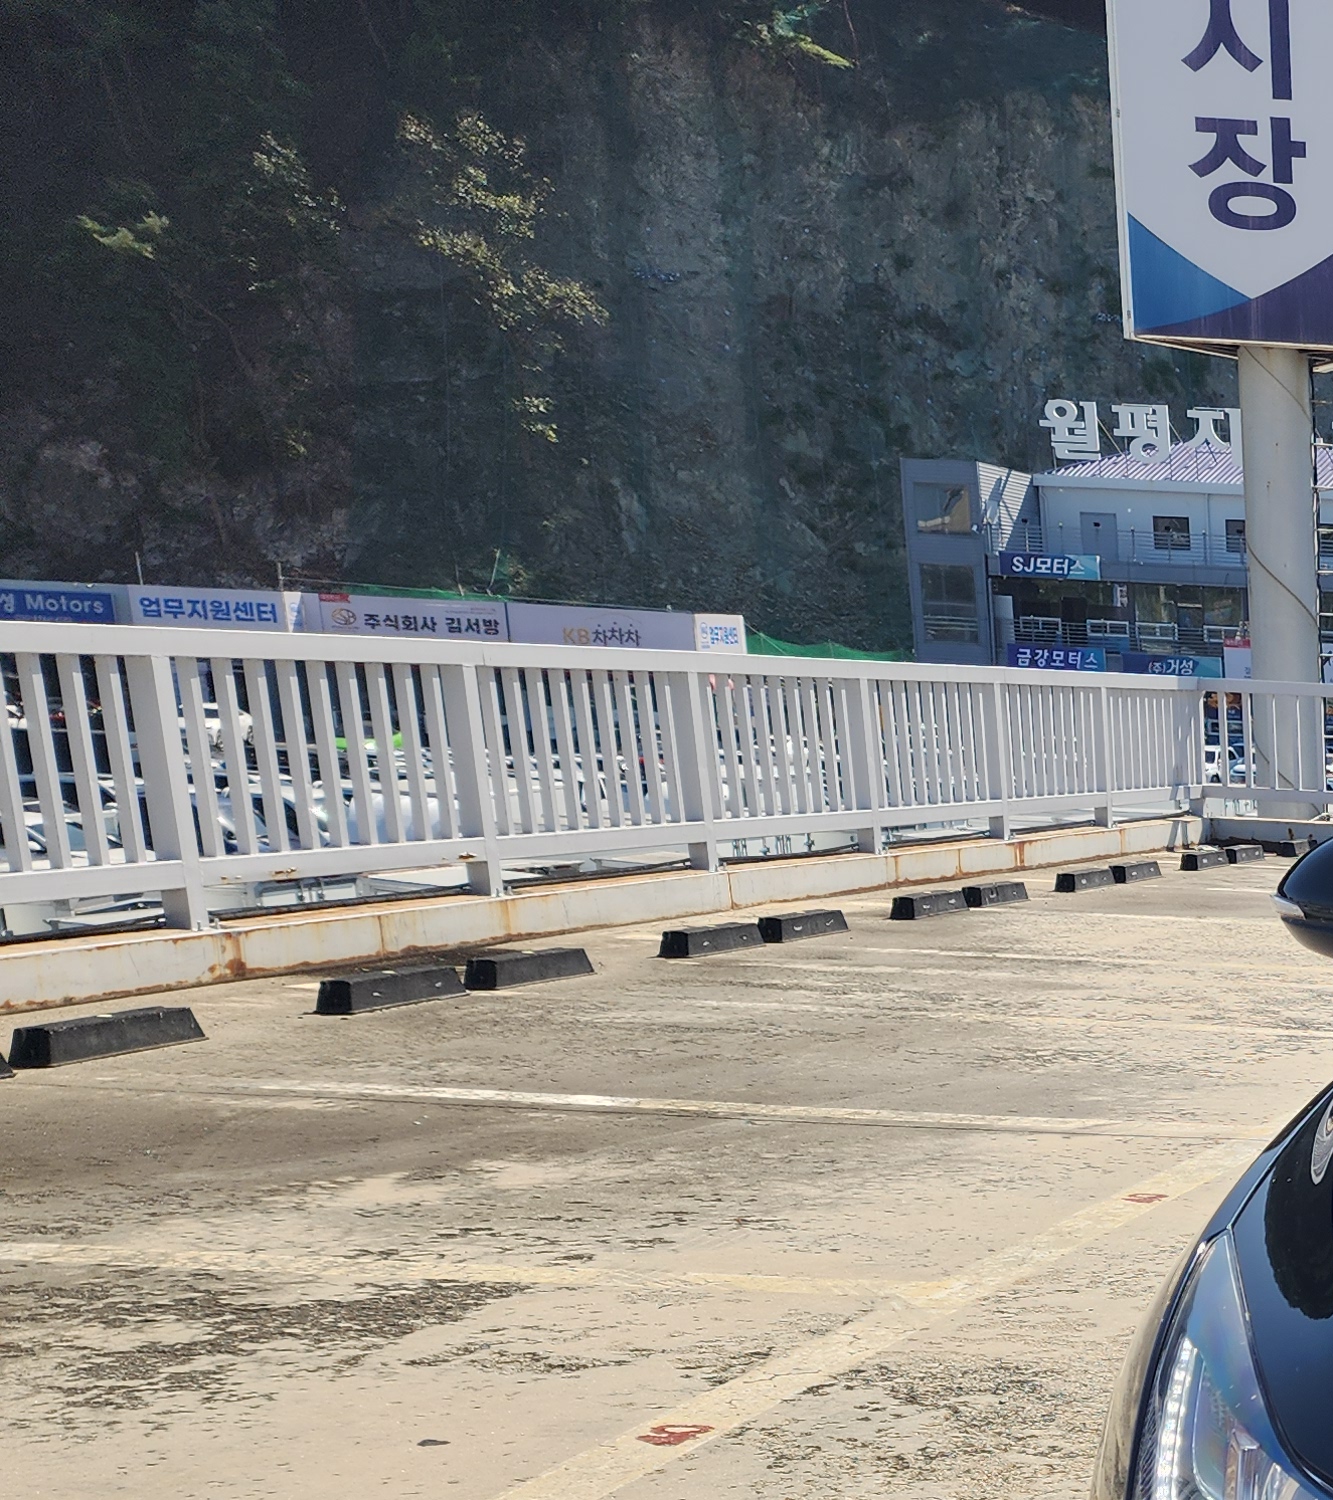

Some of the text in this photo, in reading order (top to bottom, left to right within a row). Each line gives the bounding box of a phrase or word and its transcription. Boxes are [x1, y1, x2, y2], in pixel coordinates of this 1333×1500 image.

[1011, 557, 1086, 576] SJ모터스
[25, 593, 104, 614] Motors
[138, 596, 279, 624] 업무지원센터
[363, 613, 500, 636] 주식회사 김서방
[1016, 648, 1099, 669] 금강모터스
